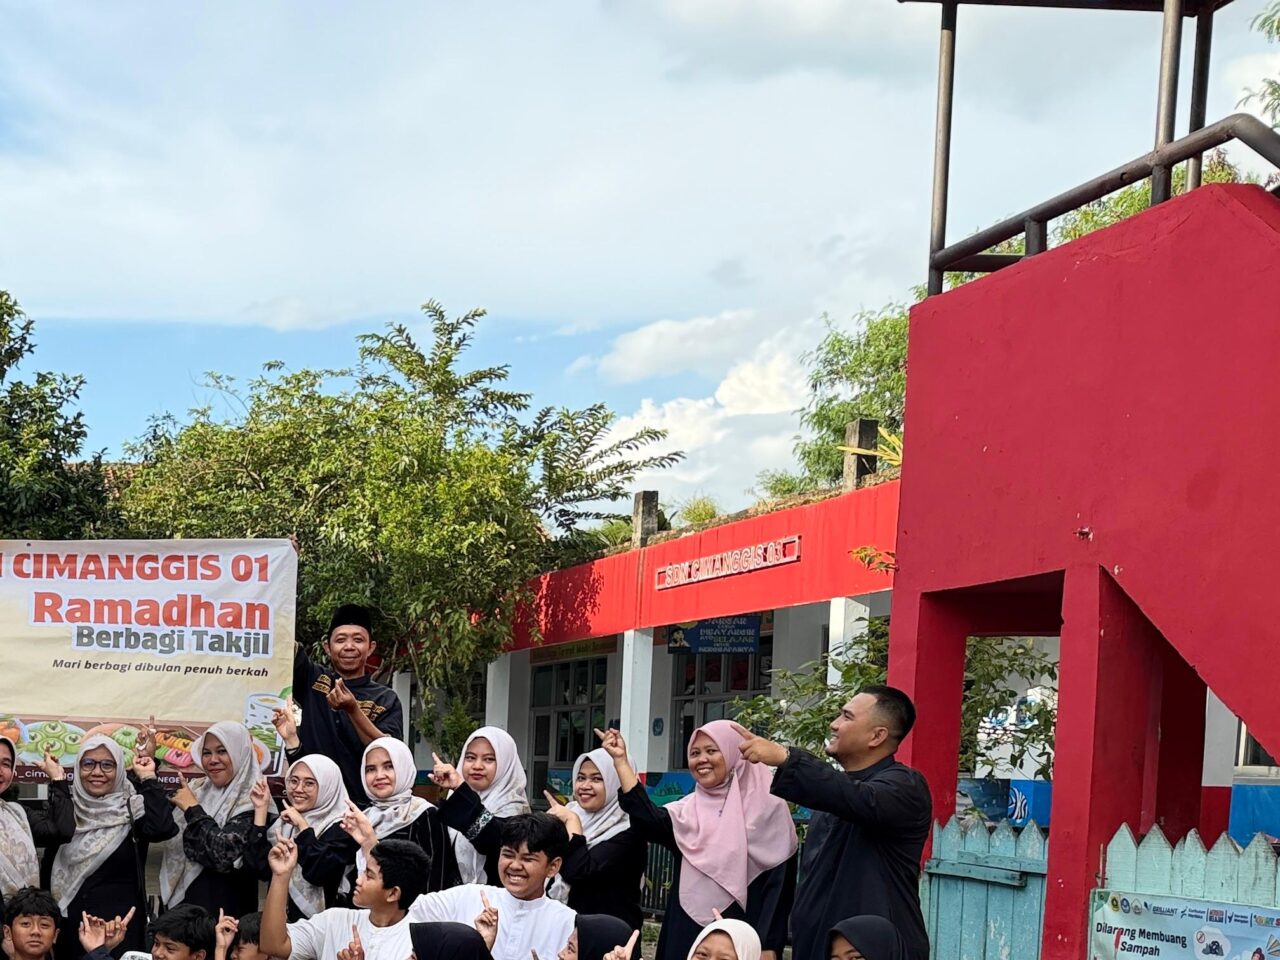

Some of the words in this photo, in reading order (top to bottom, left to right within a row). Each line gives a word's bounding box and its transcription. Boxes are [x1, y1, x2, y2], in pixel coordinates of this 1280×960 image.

[13, 552, 222, 581] CIMANGGIS
[231, 554, 269, 582] 01
[665, 564, 689, 588] SDN
[691, 545, 765, 582] CIMANGGIS
[33, 592, 270, 630] Ramadhan
[76, 626, 185, 654] Berbagi
[192, 630, 270, 658] Takjil
[52, 659, 81, 669] Mari
[84, 660, 131, 673] berbagi
[134, 662, 181, 673] dibulan
[184, 664, 223, 676] penuh
[226, 666, 269, 678] berkah
[1152, 906, 1178, 914] BRILLIANT
[1096, 922, 1136, 940] Dilarang
[1138, 928, 1187, 948] Membuang
[1120, 941, 1160, 957] Sampah
